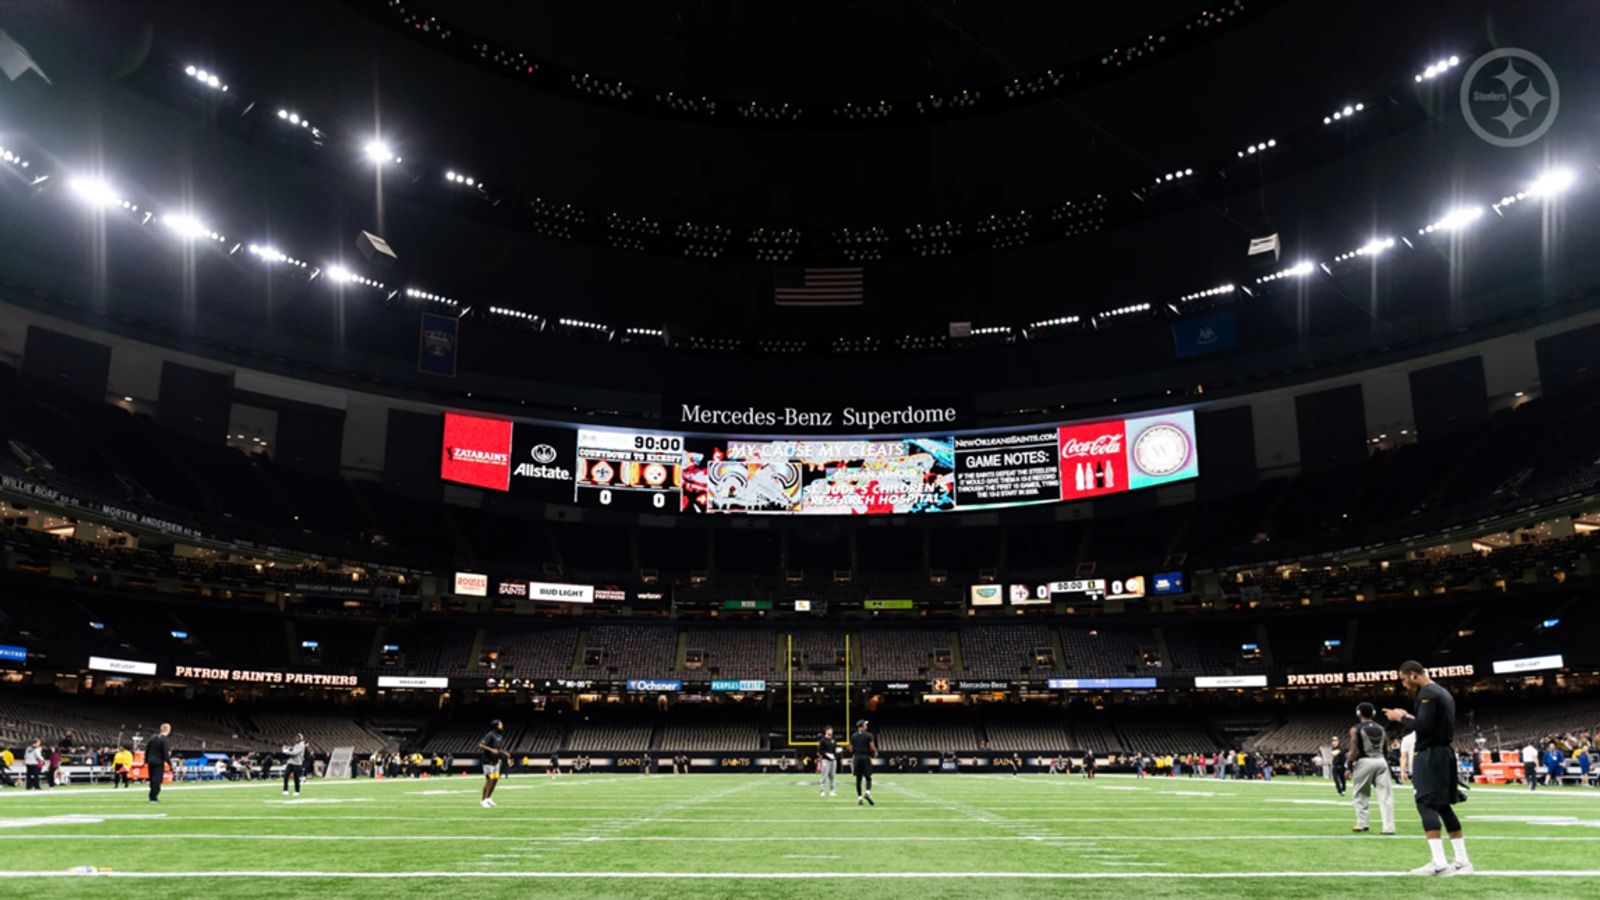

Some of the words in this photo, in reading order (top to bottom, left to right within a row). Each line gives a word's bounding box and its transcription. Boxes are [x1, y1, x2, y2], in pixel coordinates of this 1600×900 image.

[681, 404, 832, 427] Mercedes-Benz
[843, 406, 956, 429] Superdome
[634, 436, 681, 452] 90:00
[1062, 433, 1124, 459] Coca-Cola
[760, 444, 813, 457] CAUSE
[819, 444, 845, 457] MY
[633, 453, 646, 462] TO
[966, 455, 1002, 469] GAME
[1003, 450, 1050, 466] NOTES:
[996, 469, 1016, 477] DEFEAT
[1032, 473, 1057, 481] RECORD
[1, 475, 33, 495] WILLIE
[34, 484, 58, 499] ROAF
[872, 483, 949, 494] CHILDREN'S
[957, 485, 985, 493] THROUGH
[600, 489, 612, 505] 0
[653, 493, 665, 508] 0
[879, 493, 941, 505] HOSPITAL
[102, 504, 138, 522] MORTEN
[140, 511, 184, 533] ANDERSEN
[457, 576, 486, 588] ROUSES
[538, 588, 559, 597] BUD
[559, 589, 585, 598] LIGHT
[636, 592, 662, 600] verizon
[175, 665, 229, 680] PATRON
[231, 670, 283, 684] SAINTS
[285, 673, 358, 686] PARTNERS
[1287, 672, 1344, 686] PATRON
[1346, 669, 1398, 683] SAINTS
[636, 680, 678, 692] Ochsner
[959, 681, 1008, 689] Mercedes-Benz
[617, 758, 642, 767] SAINT
